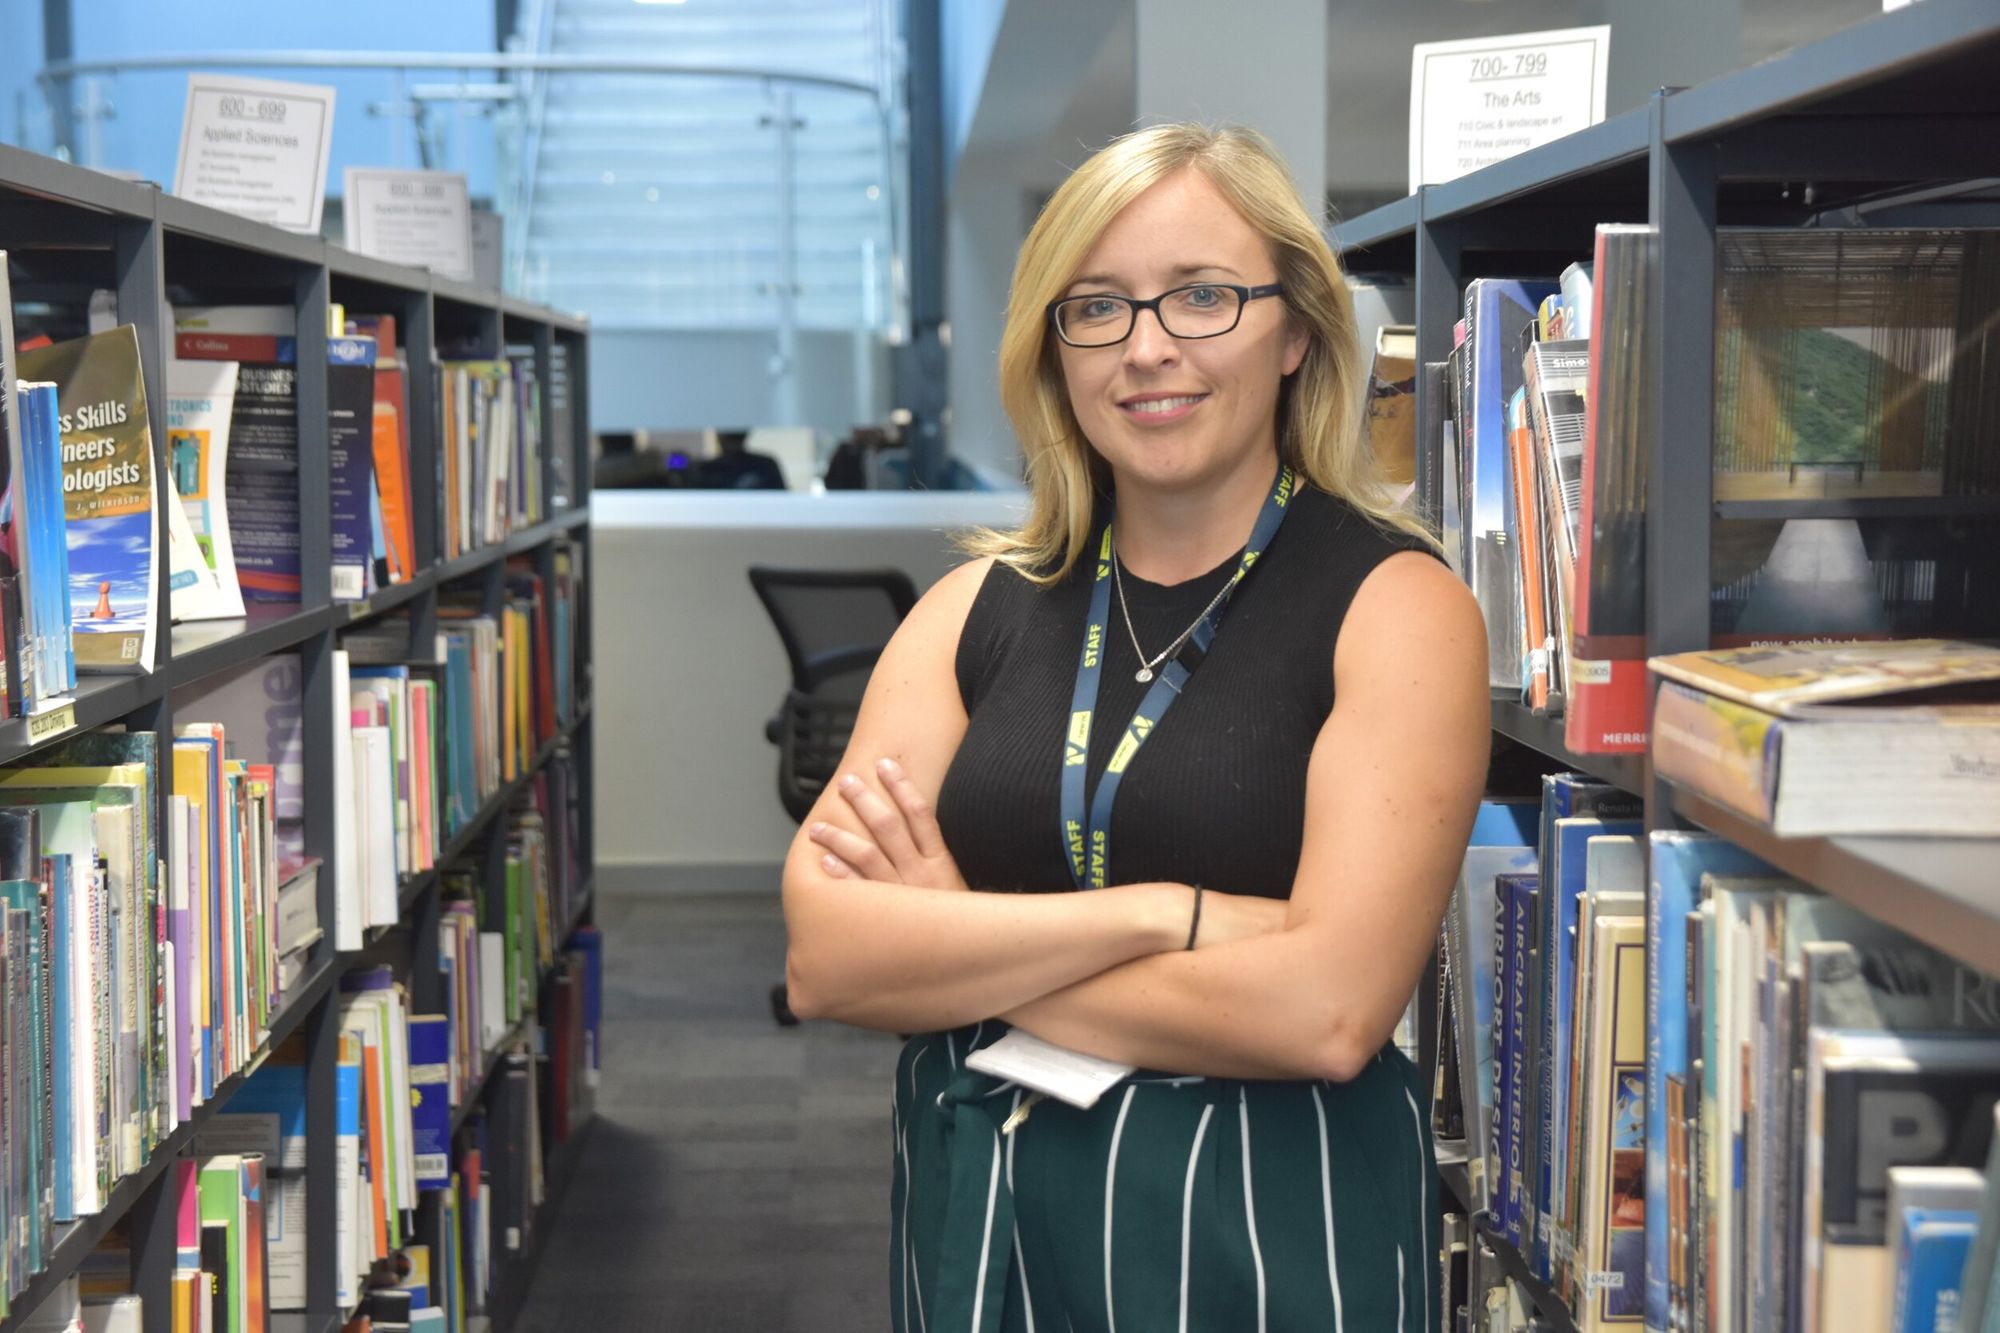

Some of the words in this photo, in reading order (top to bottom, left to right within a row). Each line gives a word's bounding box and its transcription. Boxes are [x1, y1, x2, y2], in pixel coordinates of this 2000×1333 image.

[1470, 57, 1508, 78] 700-
[1515, 53, 1547, 74] 799
[219, 96, 245, 115] 600
[258, 100, 287, 119] 699
[1484, 93, 1509, 108] The
[1512, 91, 1541, 107] Arts
[202, 126, 243, 144] Applied
[245, 128, 299, 148] Sciences
[1496, 137, 1530, 150] planning
[1464, 295, 1474, 332] Daniel
[1464, 335, 1473, 391] Libeskind
[241, 382, 292, 395] STUDIES
[77, 400, 126, 430] Skills
[64, 461, 140, 493] ologists
[1274, 464, 1294, 507] STAFF
[1084, 623, 1102, 668] STAFF
[1066, 820, 1086, 876] STAFF
[1091, 830, 1105, 888] STAFF
[88, 884, 98, 955] ARDUINO
[126, 882, 134, 920] BOOK
[1493, 894, 1504, 1048] AIRPORT
[1514, 900, 1524, 1041] AIRCRAFT
[1650, 881, 1663, 1026] Celebrating
[1650, 1036, 1661, 1112] Moore
[1490, 1059, 1502, 1182] DESIG
[1510, 1052, 1522, 1204] INTERIOS
